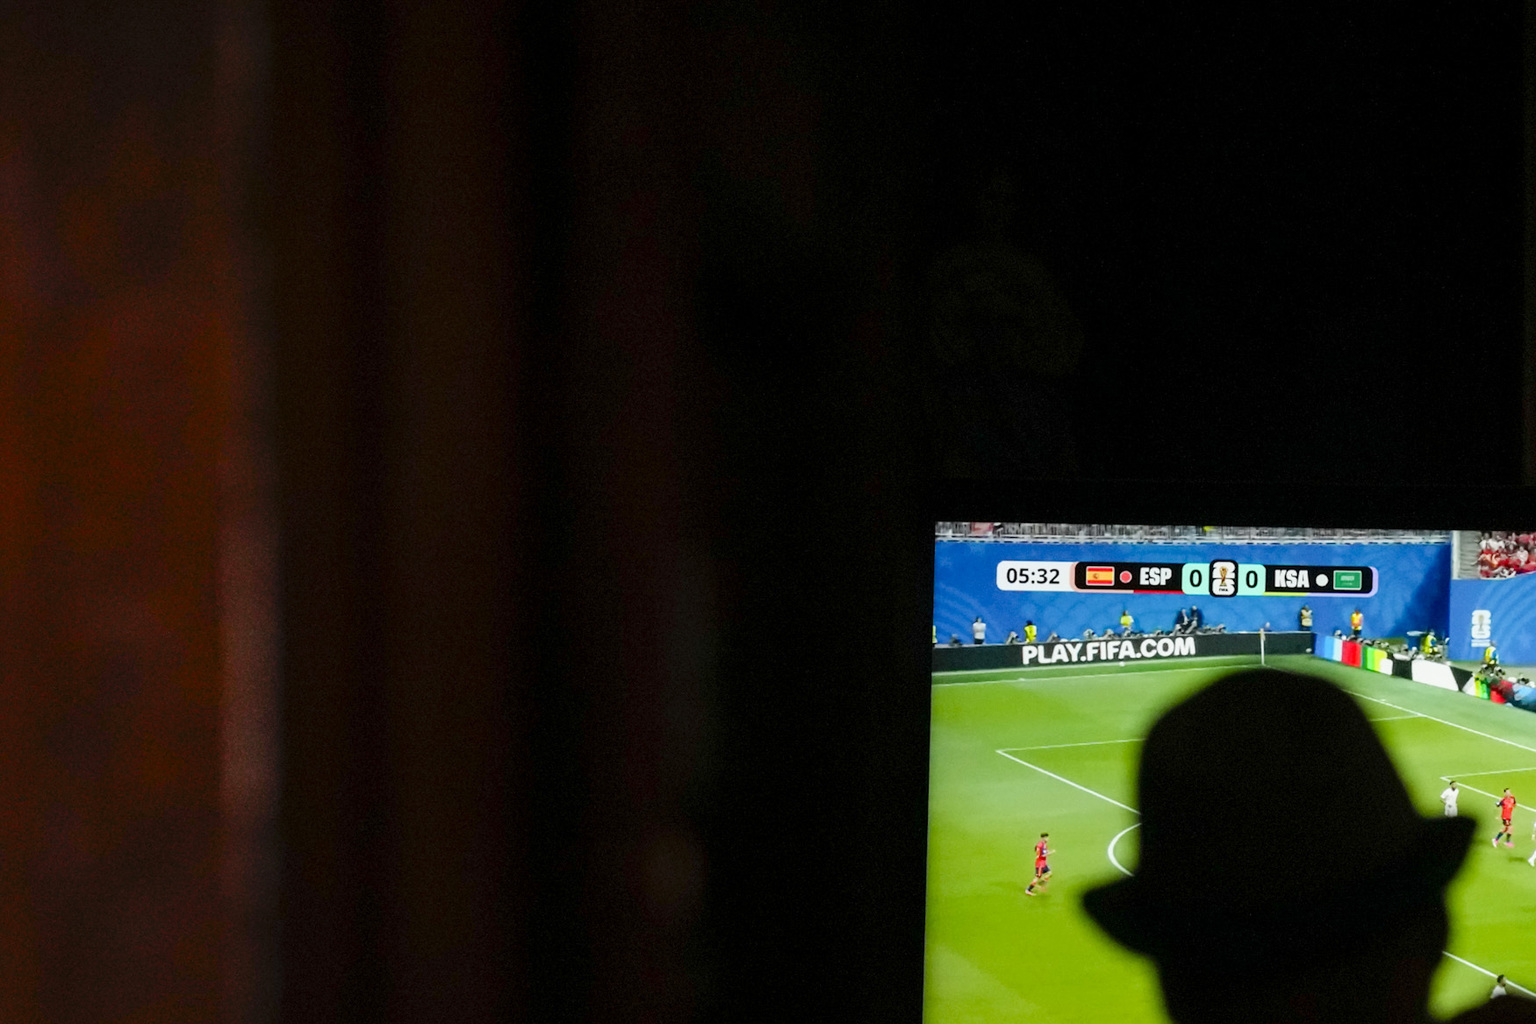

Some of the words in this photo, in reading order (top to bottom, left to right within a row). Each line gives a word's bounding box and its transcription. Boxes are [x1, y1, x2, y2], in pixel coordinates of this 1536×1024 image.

[1006, 568, 1060, 585] 05:32
[1139, 567, 1172, 586] ESP
[1190, 569, 1202, 588] 0
[1246, 570, 1258, 589] 0
[1274, 569, 1310, 588] KSA
[1022, 637, 1196, 666] PLAY.FIFA.COM
